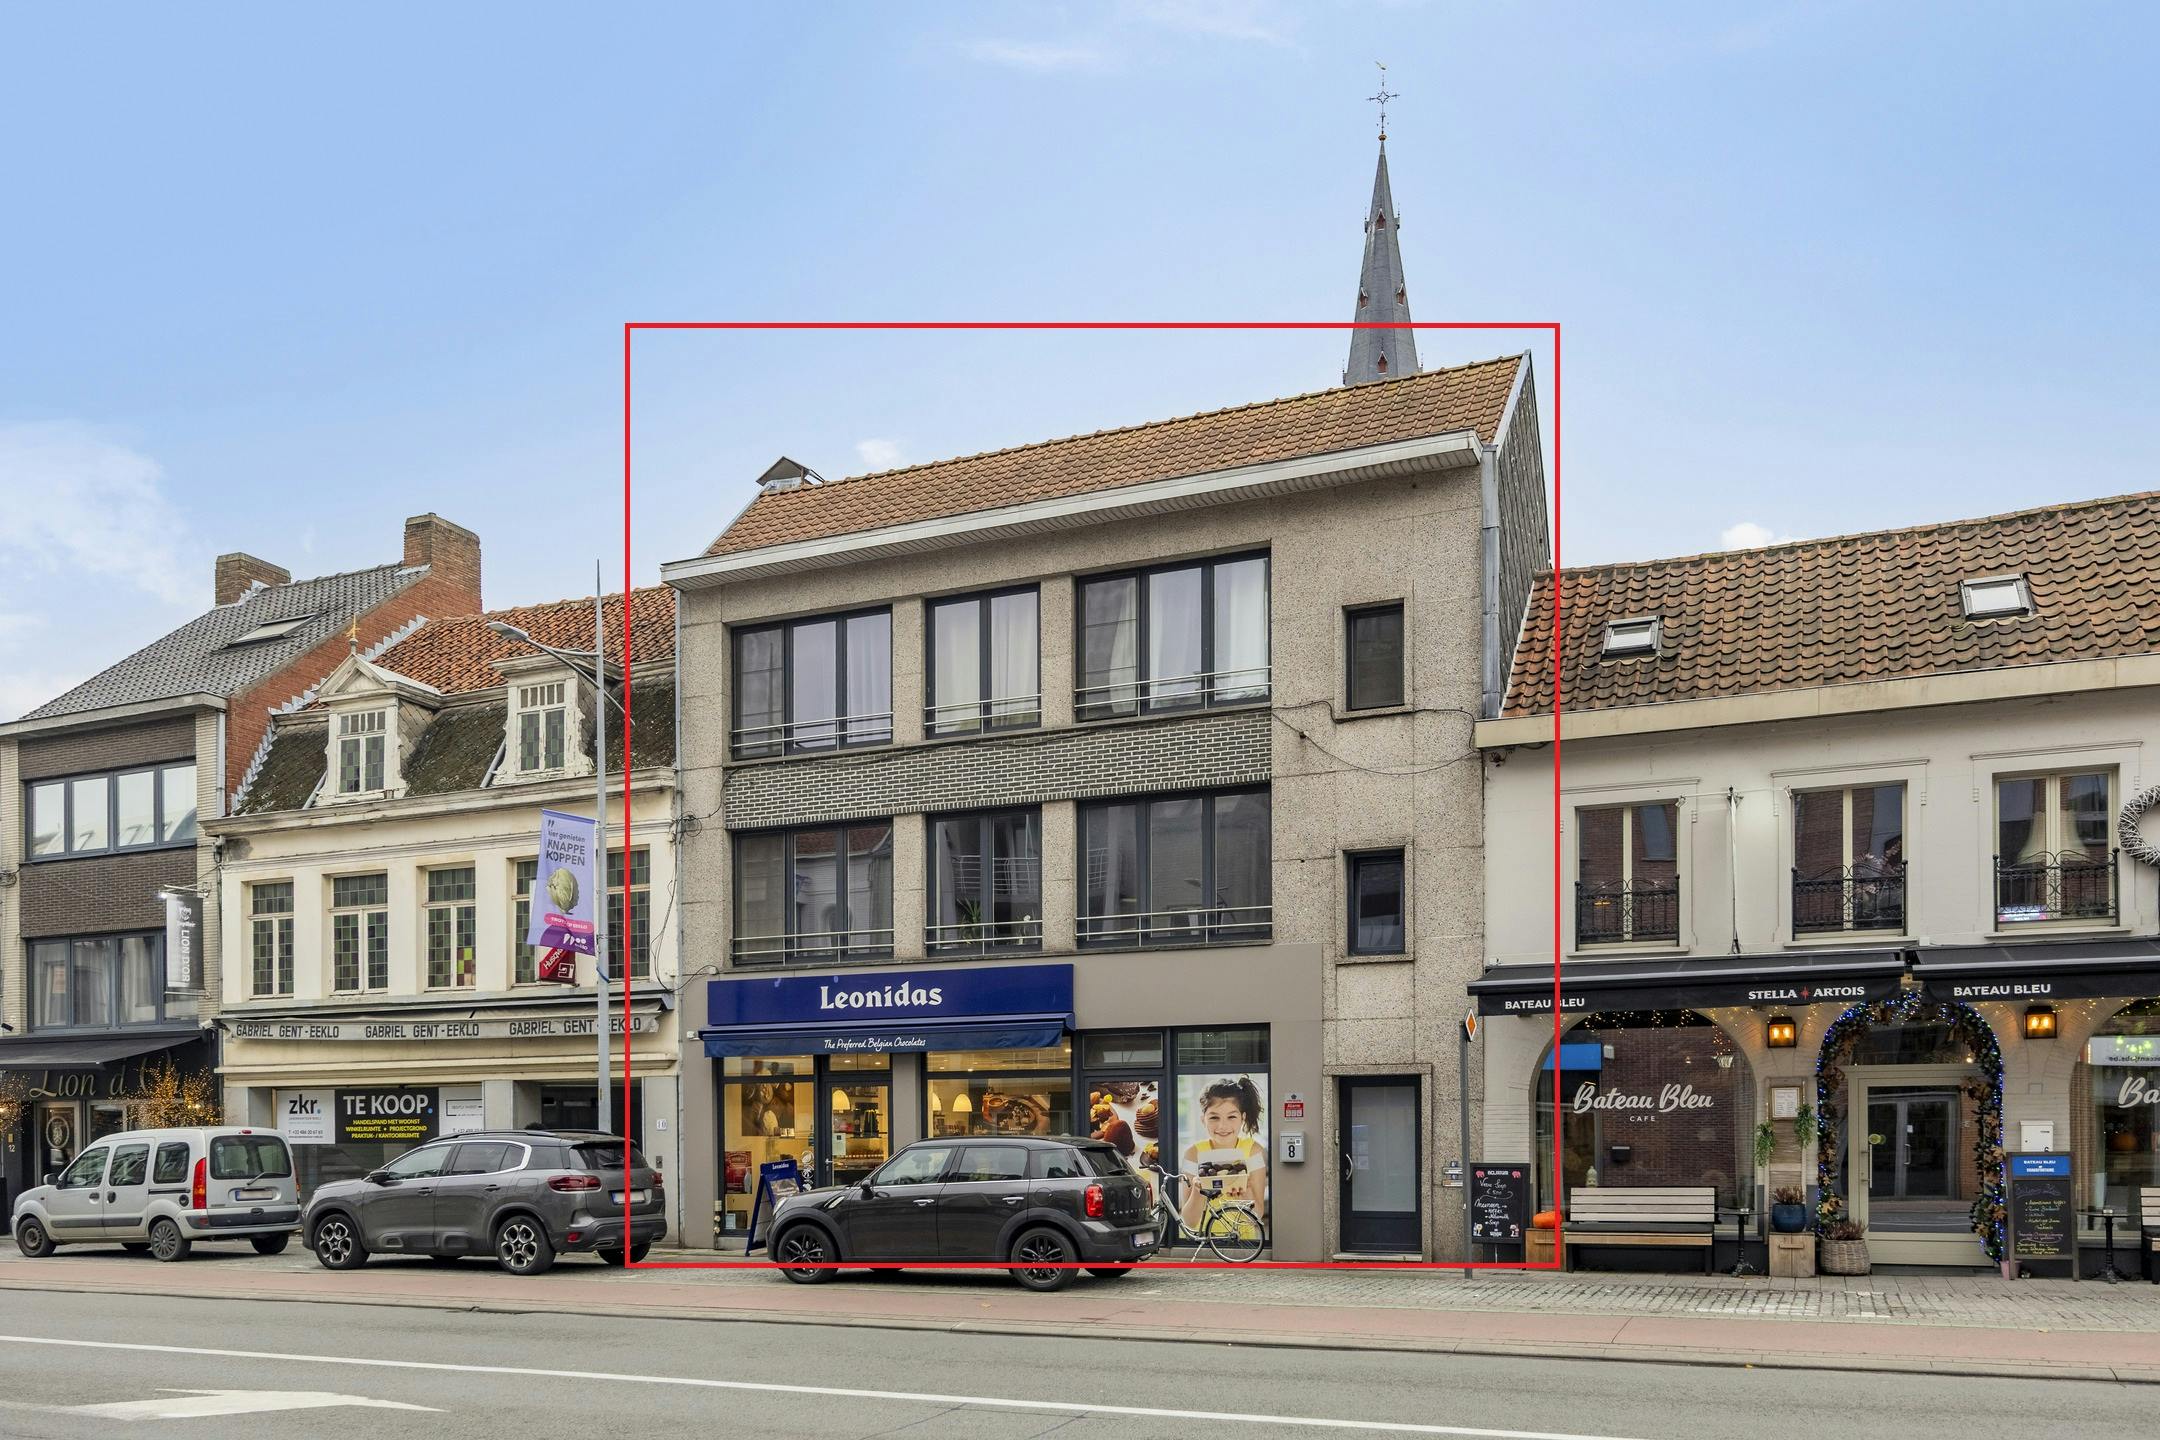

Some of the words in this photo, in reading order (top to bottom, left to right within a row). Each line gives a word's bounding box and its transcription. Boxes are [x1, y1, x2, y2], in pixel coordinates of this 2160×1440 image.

[548, 839, 585, 855] KNAPPE
[546, 850, 585, 866] KOPPEN
[181, 929, 190, 954] LION
[820, 981, 943, 1009] Leonidas
[1748, 989, 1797, 999] STELLA
[1813, 986, 1865, 997] ARTOIS
[1953, 985, 2010, 996] BATEAU
[2014, 983, 2051, 994] BLEU
[1505, 1000, 1552, 1010] BATEAU
[1559, 998, 1585, 1008] LEU
[236, 1024, 273, 1037] GABRIEL
[365, 1025, 406, 1038] GABRIEL
[509, 1021, 556, 1035] GABRIEL
[824, 1039, 835, 1049] The
[836, 1038, 867, 1051] Preferred
[867, 1037, 893, 1052] Belgian
[893, 1036, 926, 1047] Chocolates
[29, 1070, 96, 1098] Lion
[343, 1095, 366, 1115] TE
[1573, 1083, 1654, 1114] Bateau
[1658, 1083, 1714, 1113] Bleu
[1288, 1145, 1295, 1158] 8
